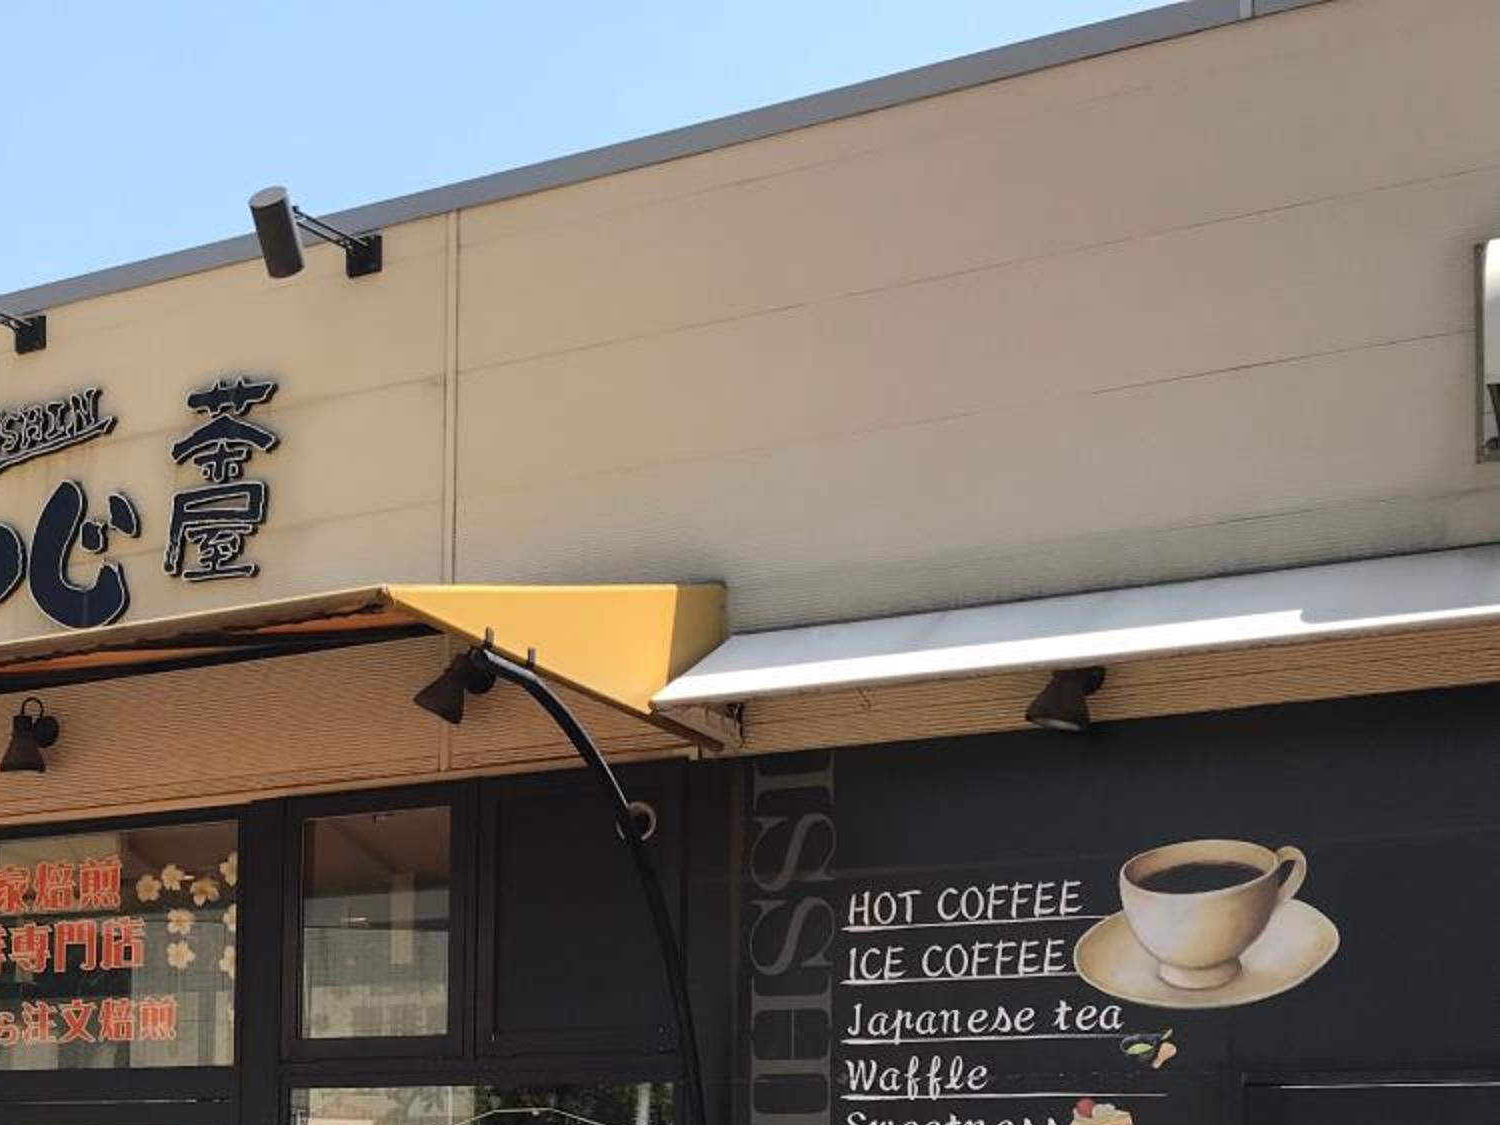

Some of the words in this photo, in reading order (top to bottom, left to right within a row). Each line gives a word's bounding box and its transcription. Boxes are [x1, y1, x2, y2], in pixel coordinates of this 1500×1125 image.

[848, 890, 922, 927] HOT
[937, 880, 1082, 922] COFFEE
[848, 946, 906, 982] ICE
[921, 938, 1068, 978] COFFEE
[846, 1002, 1036, 1044] Japanese
[1053, 1000, 1124, 1033] tea
[846, 1055, 989, 1100] Waffle
